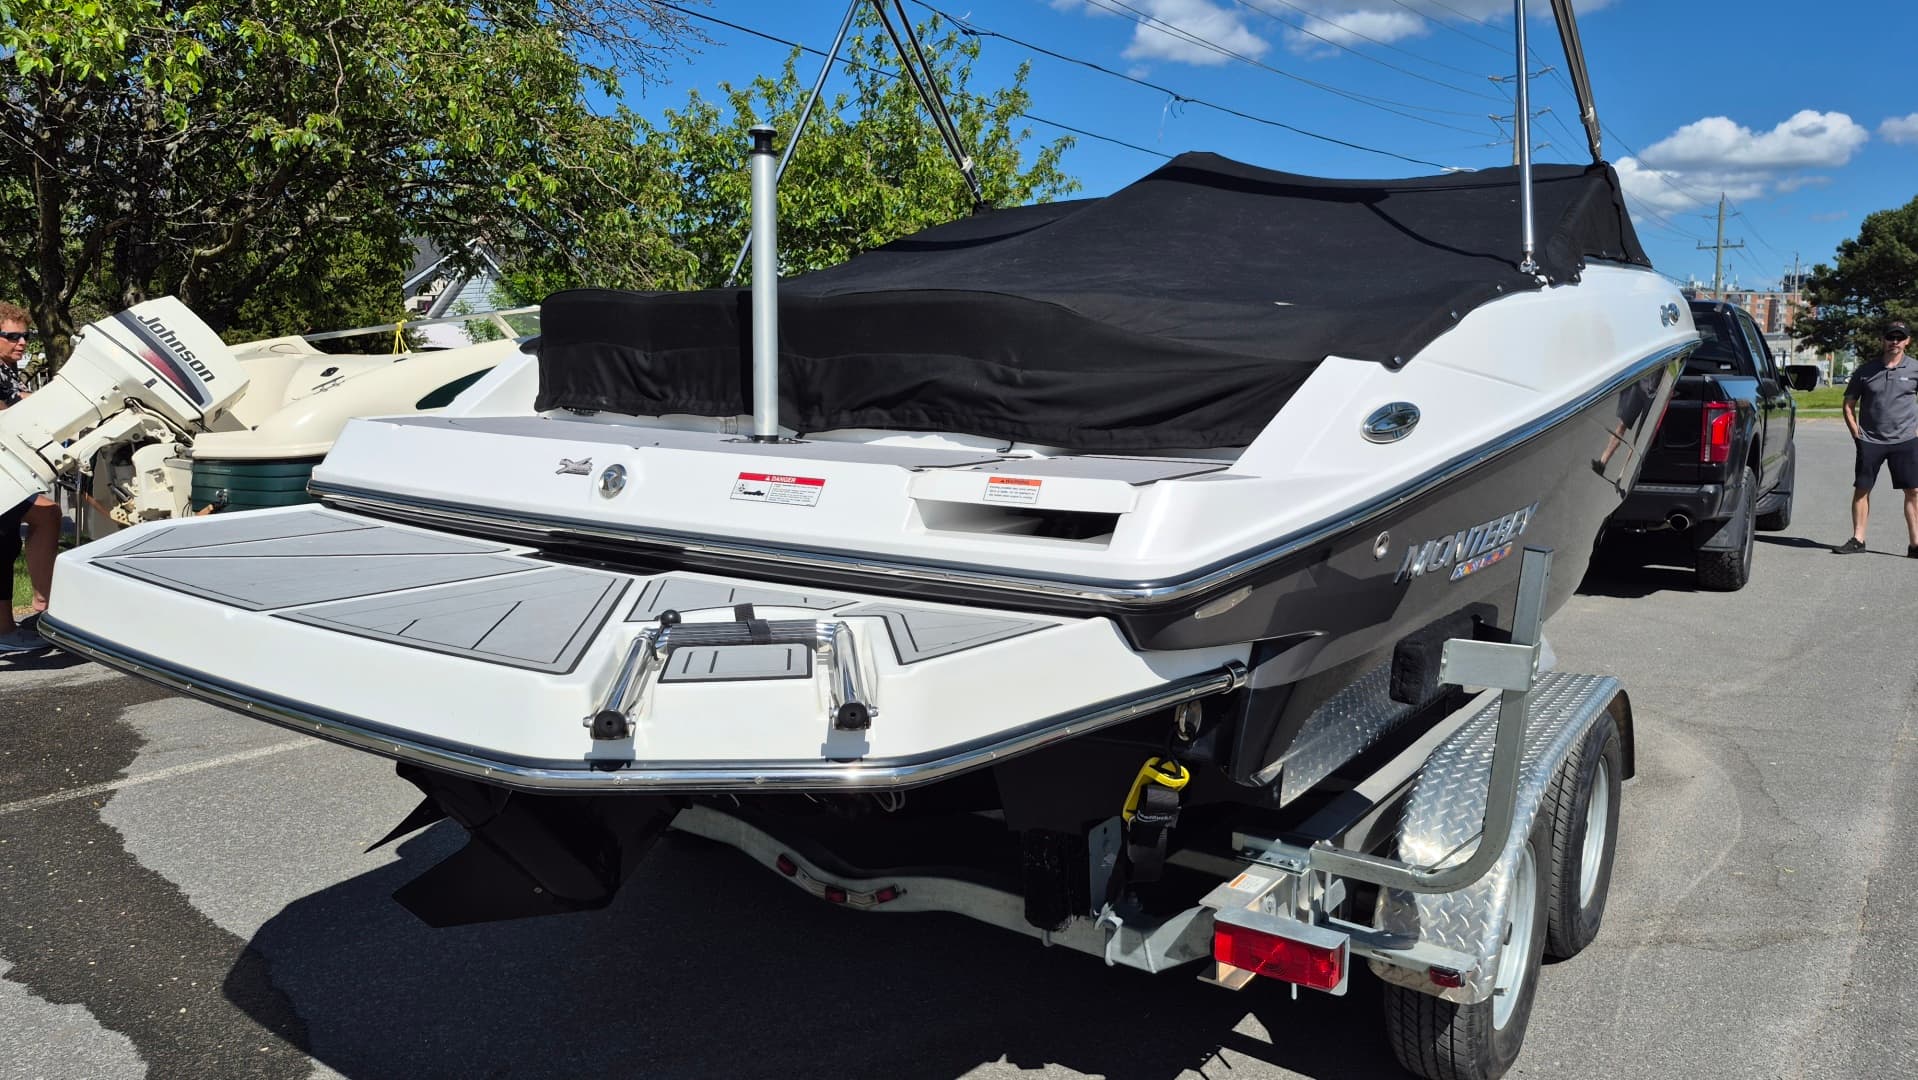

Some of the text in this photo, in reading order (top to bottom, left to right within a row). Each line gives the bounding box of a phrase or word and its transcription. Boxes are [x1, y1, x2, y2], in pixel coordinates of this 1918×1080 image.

[137, 315, 216, 383] Johnson
[771, 475, 797, 483] DANGER
[1393, 500, 1540, 585] MONTEREY
